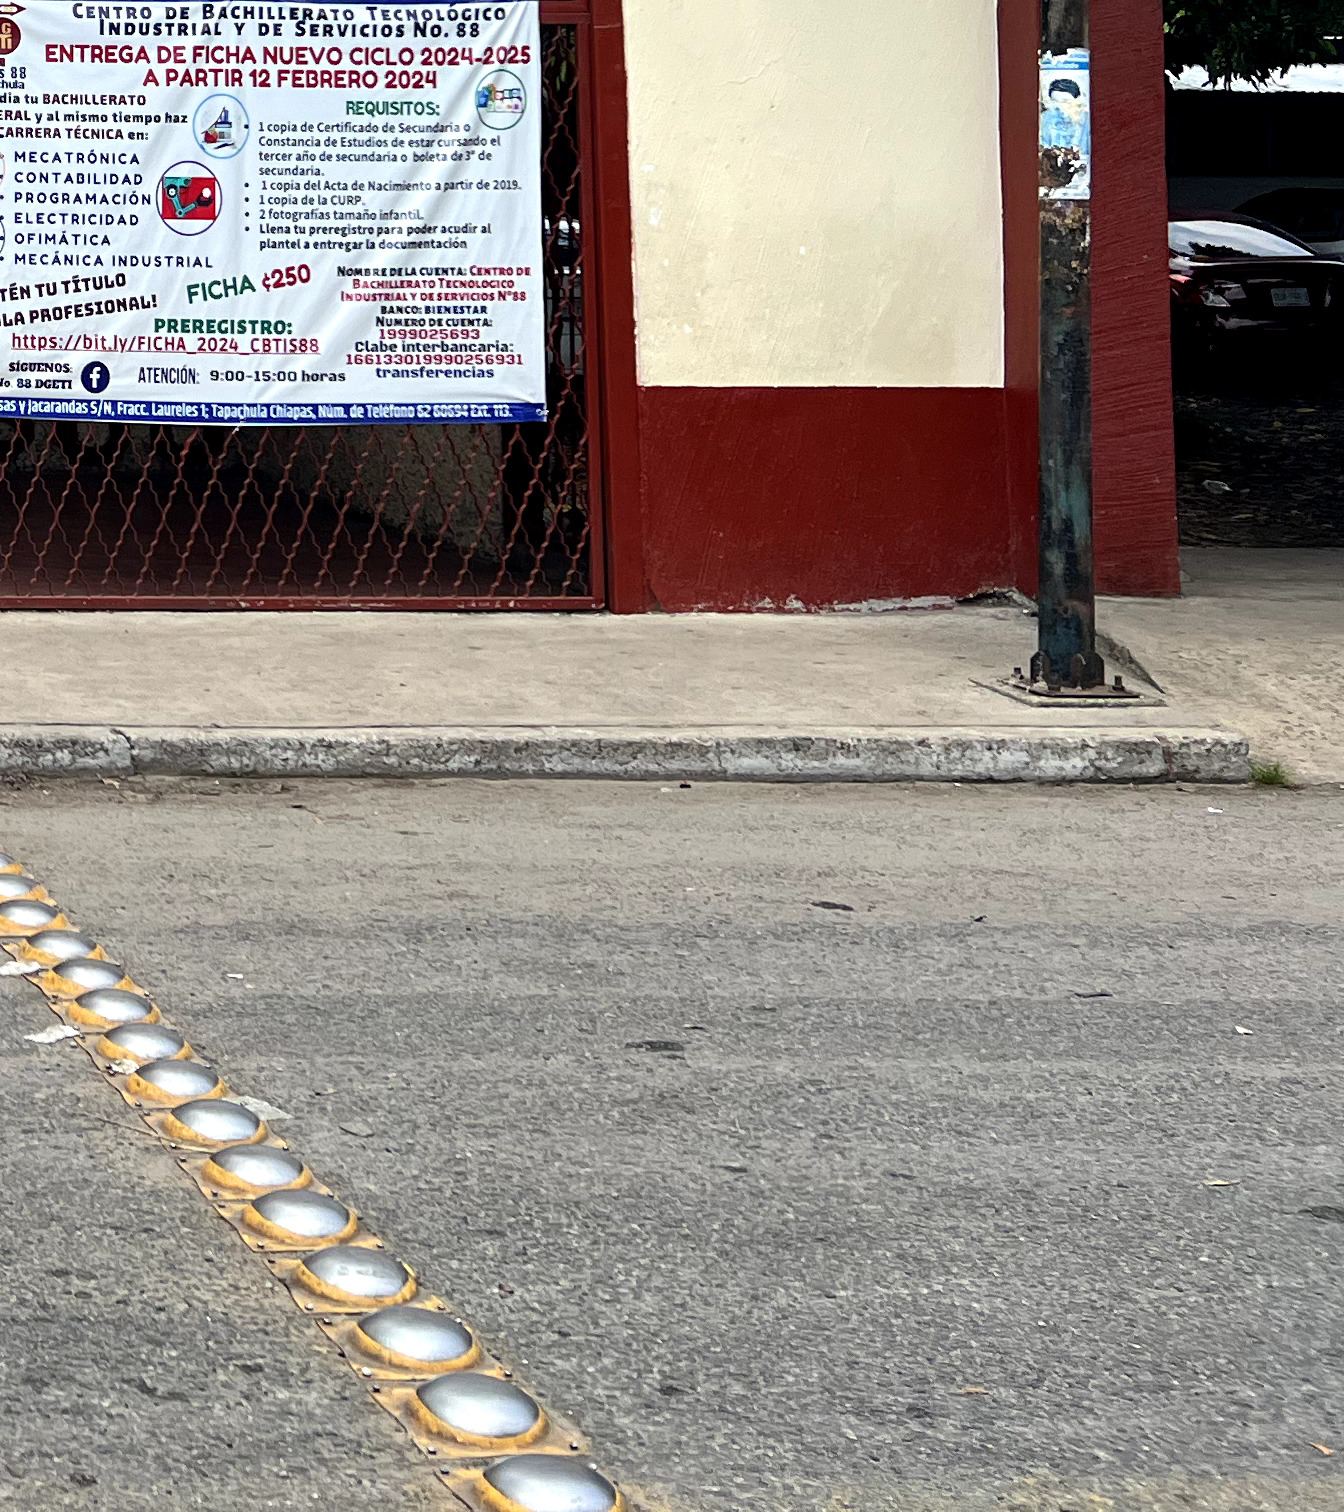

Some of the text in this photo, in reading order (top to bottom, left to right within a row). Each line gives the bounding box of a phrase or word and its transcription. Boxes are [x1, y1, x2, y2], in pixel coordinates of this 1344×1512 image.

[236, 23, 246, 37] Y
[456, 22, 480, 38] 88
[45, 44, 531, 66] ENTREGA DE FICHA NUEVO CICLO 2024-2025
[10, 66, 27, 79] 88
[143, 69, 437, 89] A PARTIR 12 FEBRERO 2024
[24, 93, 39, 104] tu
[43, 93, 146, 105] BACHILLERATO
[346, 100, 440, 117] REQUISITOS:
[35, 112, 43, 124] y
[46, 110, 60, 122] al
[63, 111, 108, 123] mismo
[113, 111, 161, 126] tiempo
[165, 112, 188, 123] haz
[66, 125, 123, 140] TÉCNICA
[127, 130, 149, 140] en:
[267, 122, 471, 135] copia de Certificado de Secundaria o
[259, 136, 501, 148] Constancia de Estudios de estar cursando el
[14, 149, 140, 165] MECATRÓNICA
[259, 150, 492, 163] tercer año de secundaria o boleta de de
[14, 172, 143, 185] CONTABILIDAD
[259, 166, 325, 177] secundaria.
[270, 180, 300, 193] copia
[304, 180, 321, 191] del
[323, 180, 348, 191] Acta
[351, 180, 365, 191] de
[368, 180, 431, 192] Nacimiento
[443, 180, 474, 193] partir
[476, 180, 490, 191] de
[14, 191, 151, 206] PROGRAMACIÓN
[267, 195, 366, 208] copia de la CURP.
[14, 213, 139, 226] ELECTRICIDAD
[268, 208, 330, 223] fotografías
[333, 209, 376, 220] tamaño
[259, 223, 491, 238] Llena tu preregistro para poder acudir al
[14, 231, 111, 246] OFIMÁTICA
[259, 237, 467, 252] plantel entregar la documentación
[14, 251, 213, 268] MECÁNICA INDUSTRIAL
[34, 279, 58, 298] TU
[61, 272, 126, 293] TÍTULO
[186, 274, 256, 304] FICHA
[29, 294, 157, 324] PROFESIONAL!
[424, 305, 488, 315] BIENESTAR
[154, 318, 293, 335] PREREGISTRO:
[379, 329, 480, 340] 1999025693
[355, 340, 514, 353] Clabe interbancaria:
[138, 365, 346, 385] ATENCIÓN: 9:00-15:00 horas
[375, 366, 494, 379] transferencias
[17, 379, 31, 388] 88
[35, 379, 72, 389] DGETI
[19, 400, 26, 415] y
[27, 399, 88, 415] Jacarandas
[90, 399, 115, 417] S/N,
[117, 402, 149, 416] Fracc.
[152, 403, 198, 417] Laureles
[212, 404, 267, 420] Tapachula
[270, 405, 316, 421] Chiapas,
[350, 404, 364, 418] de
